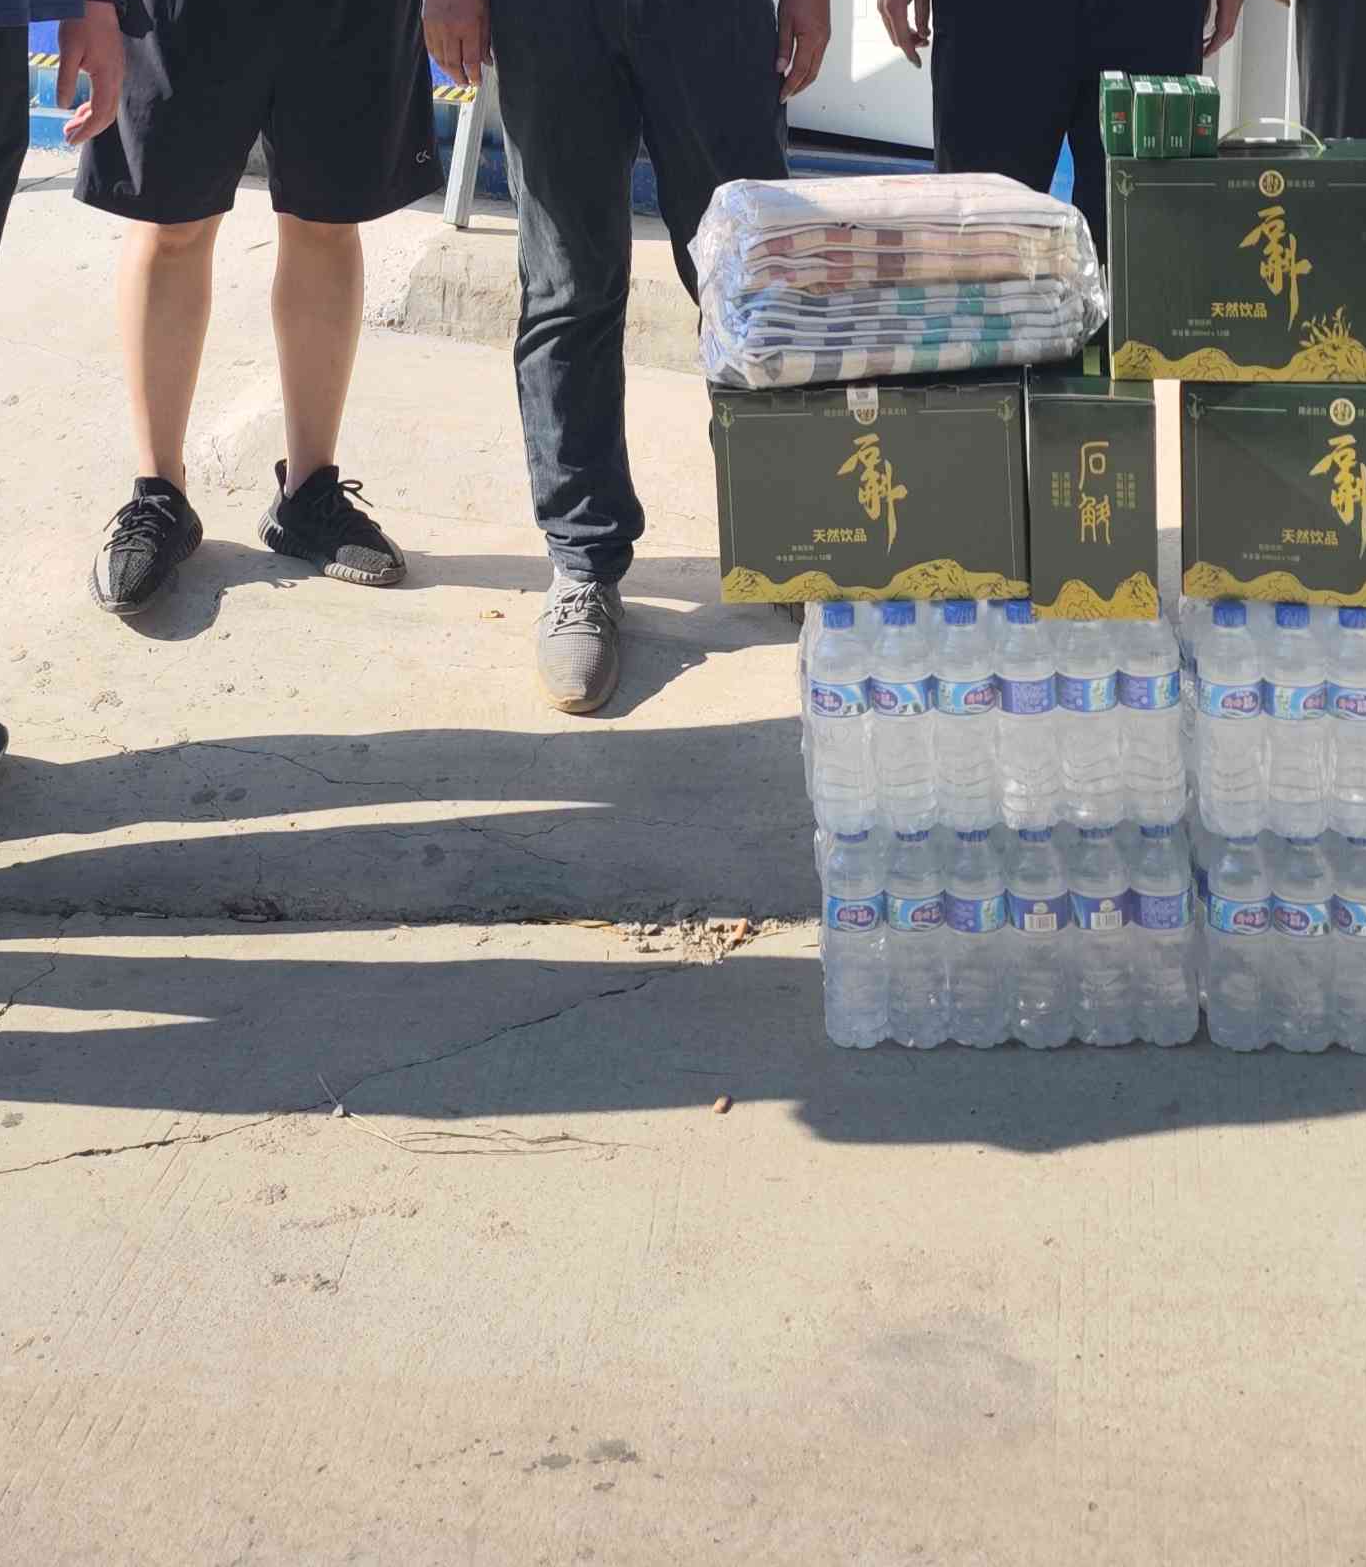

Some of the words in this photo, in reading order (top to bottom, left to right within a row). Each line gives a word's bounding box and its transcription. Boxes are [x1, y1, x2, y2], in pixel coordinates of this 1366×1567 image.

[1211, 301, 1268, 319] 天然饮品
[812, 527, 868, 544] 天然饮品
[1281, 528, 1340, 545] 天然饮品
